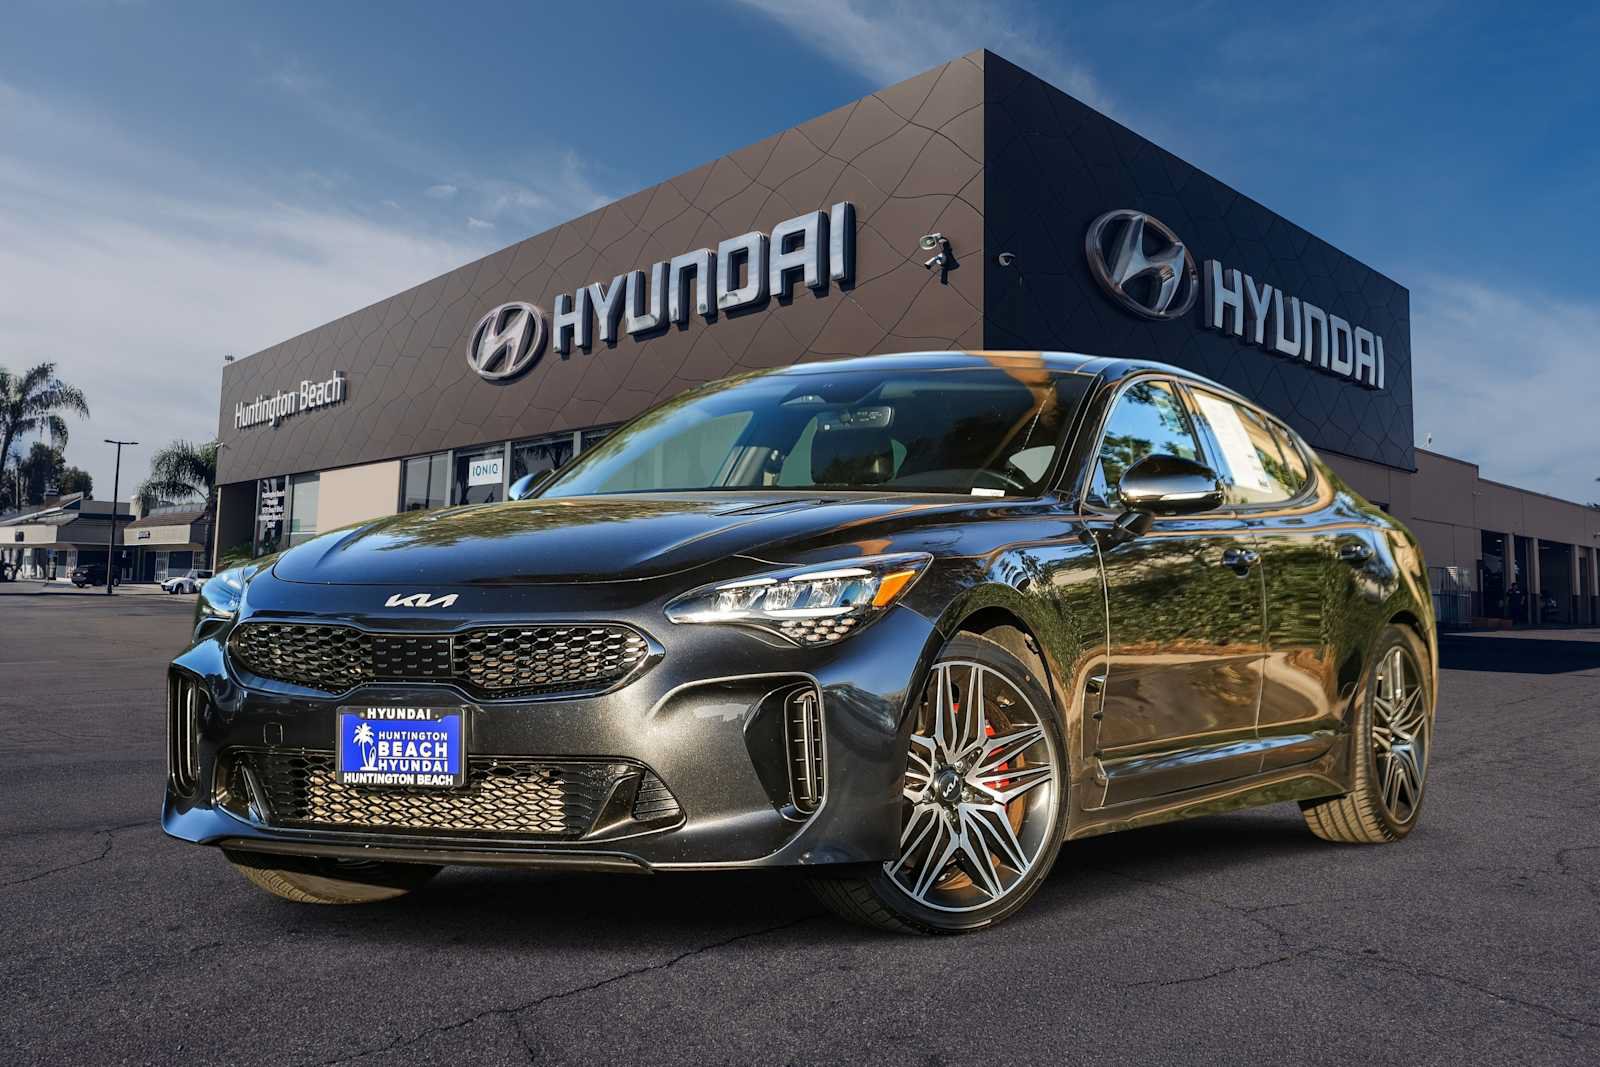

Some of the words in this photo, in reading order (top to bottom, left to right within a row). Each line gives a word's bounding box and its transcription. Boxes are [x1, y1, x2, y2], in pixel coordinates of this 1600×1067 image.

[553, 201, 853, 355] HYUNDAI
[1206, 259, 1385, 389] HYUNDAI
[234, 389, 298, 429] Huntington
[300, 370, 343, 411] Beach
[472, 463, 498, 477] IONIQ
[384, 593, 459, 607] KIA
[367, 708, 431, 720] HYUNDAI
[378, 731, 448, 741] HUNTINGTON
[378, 741, 448, 757] BEACH
[378, 759, 448, 772] HYUNDAI
[343, 772, 416, 784] HUNTINGTON
[417, 774, 453, 785] BEACH
